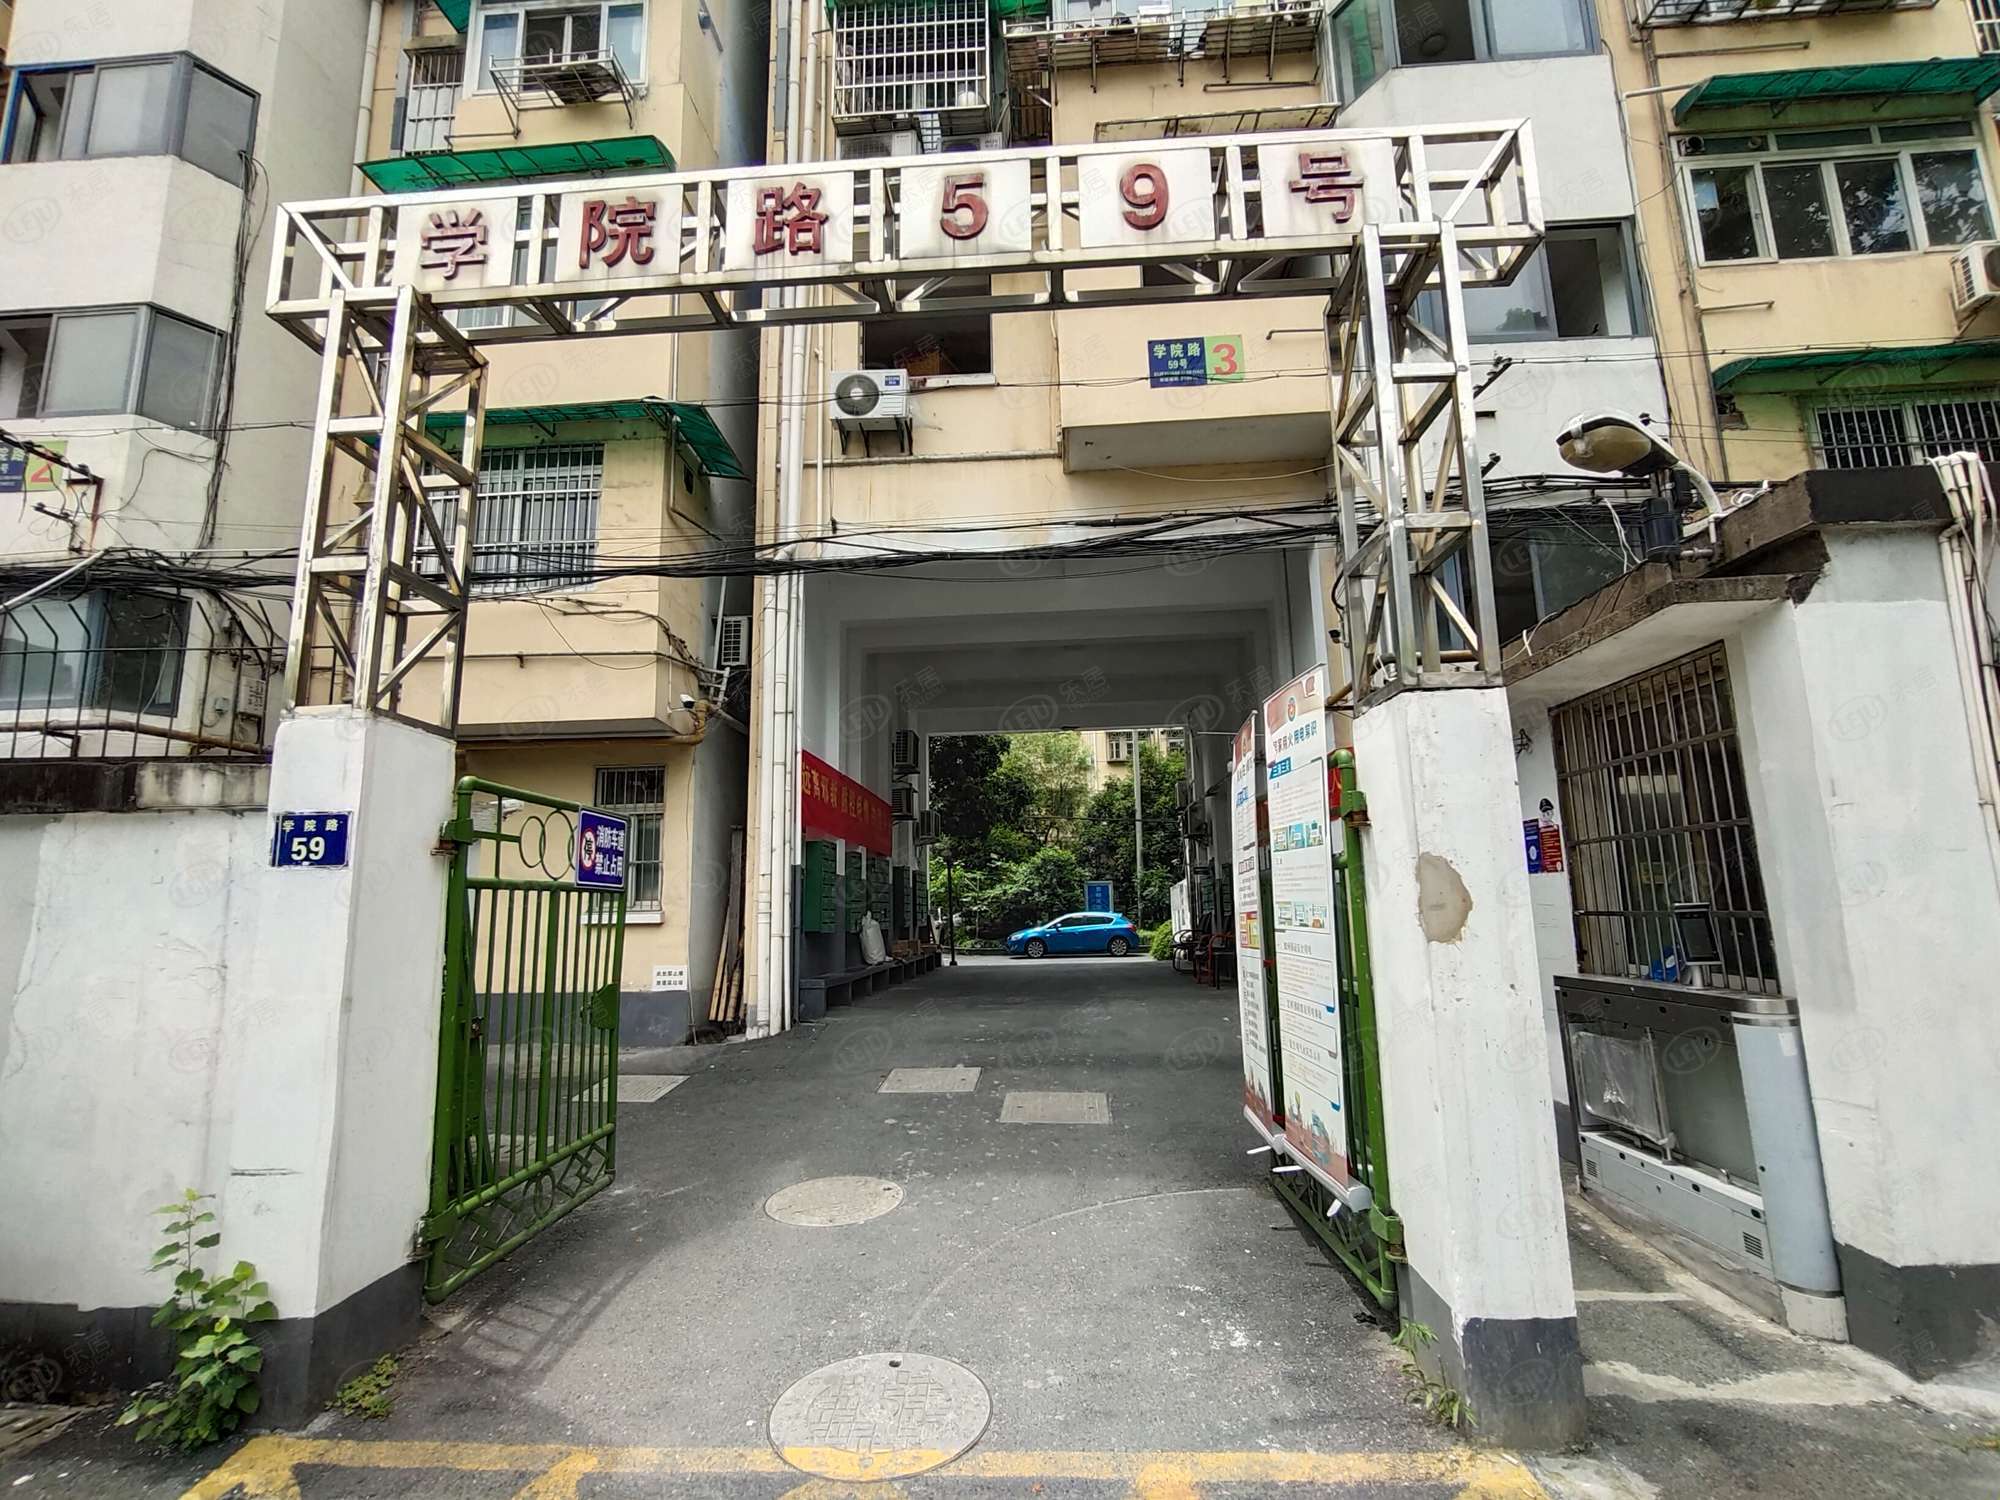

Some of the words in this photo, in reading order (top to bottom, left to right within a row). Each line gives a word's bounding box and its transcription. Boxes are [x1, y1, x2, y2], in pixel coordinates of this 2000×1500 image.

[420, 151, 1364, 280] 学院路59号
[1153, 342, 1201, 359] 学院路
[1212, 343, 1238, 376] 3
[1168, 359, 1188, 369] 59号
[282, 818, 339, 833] 学院路
[596, 824, 625, 851] 消防车道
[290, 836, 326, 861] 59
[594, 853, 623, 878] 禁止占用
